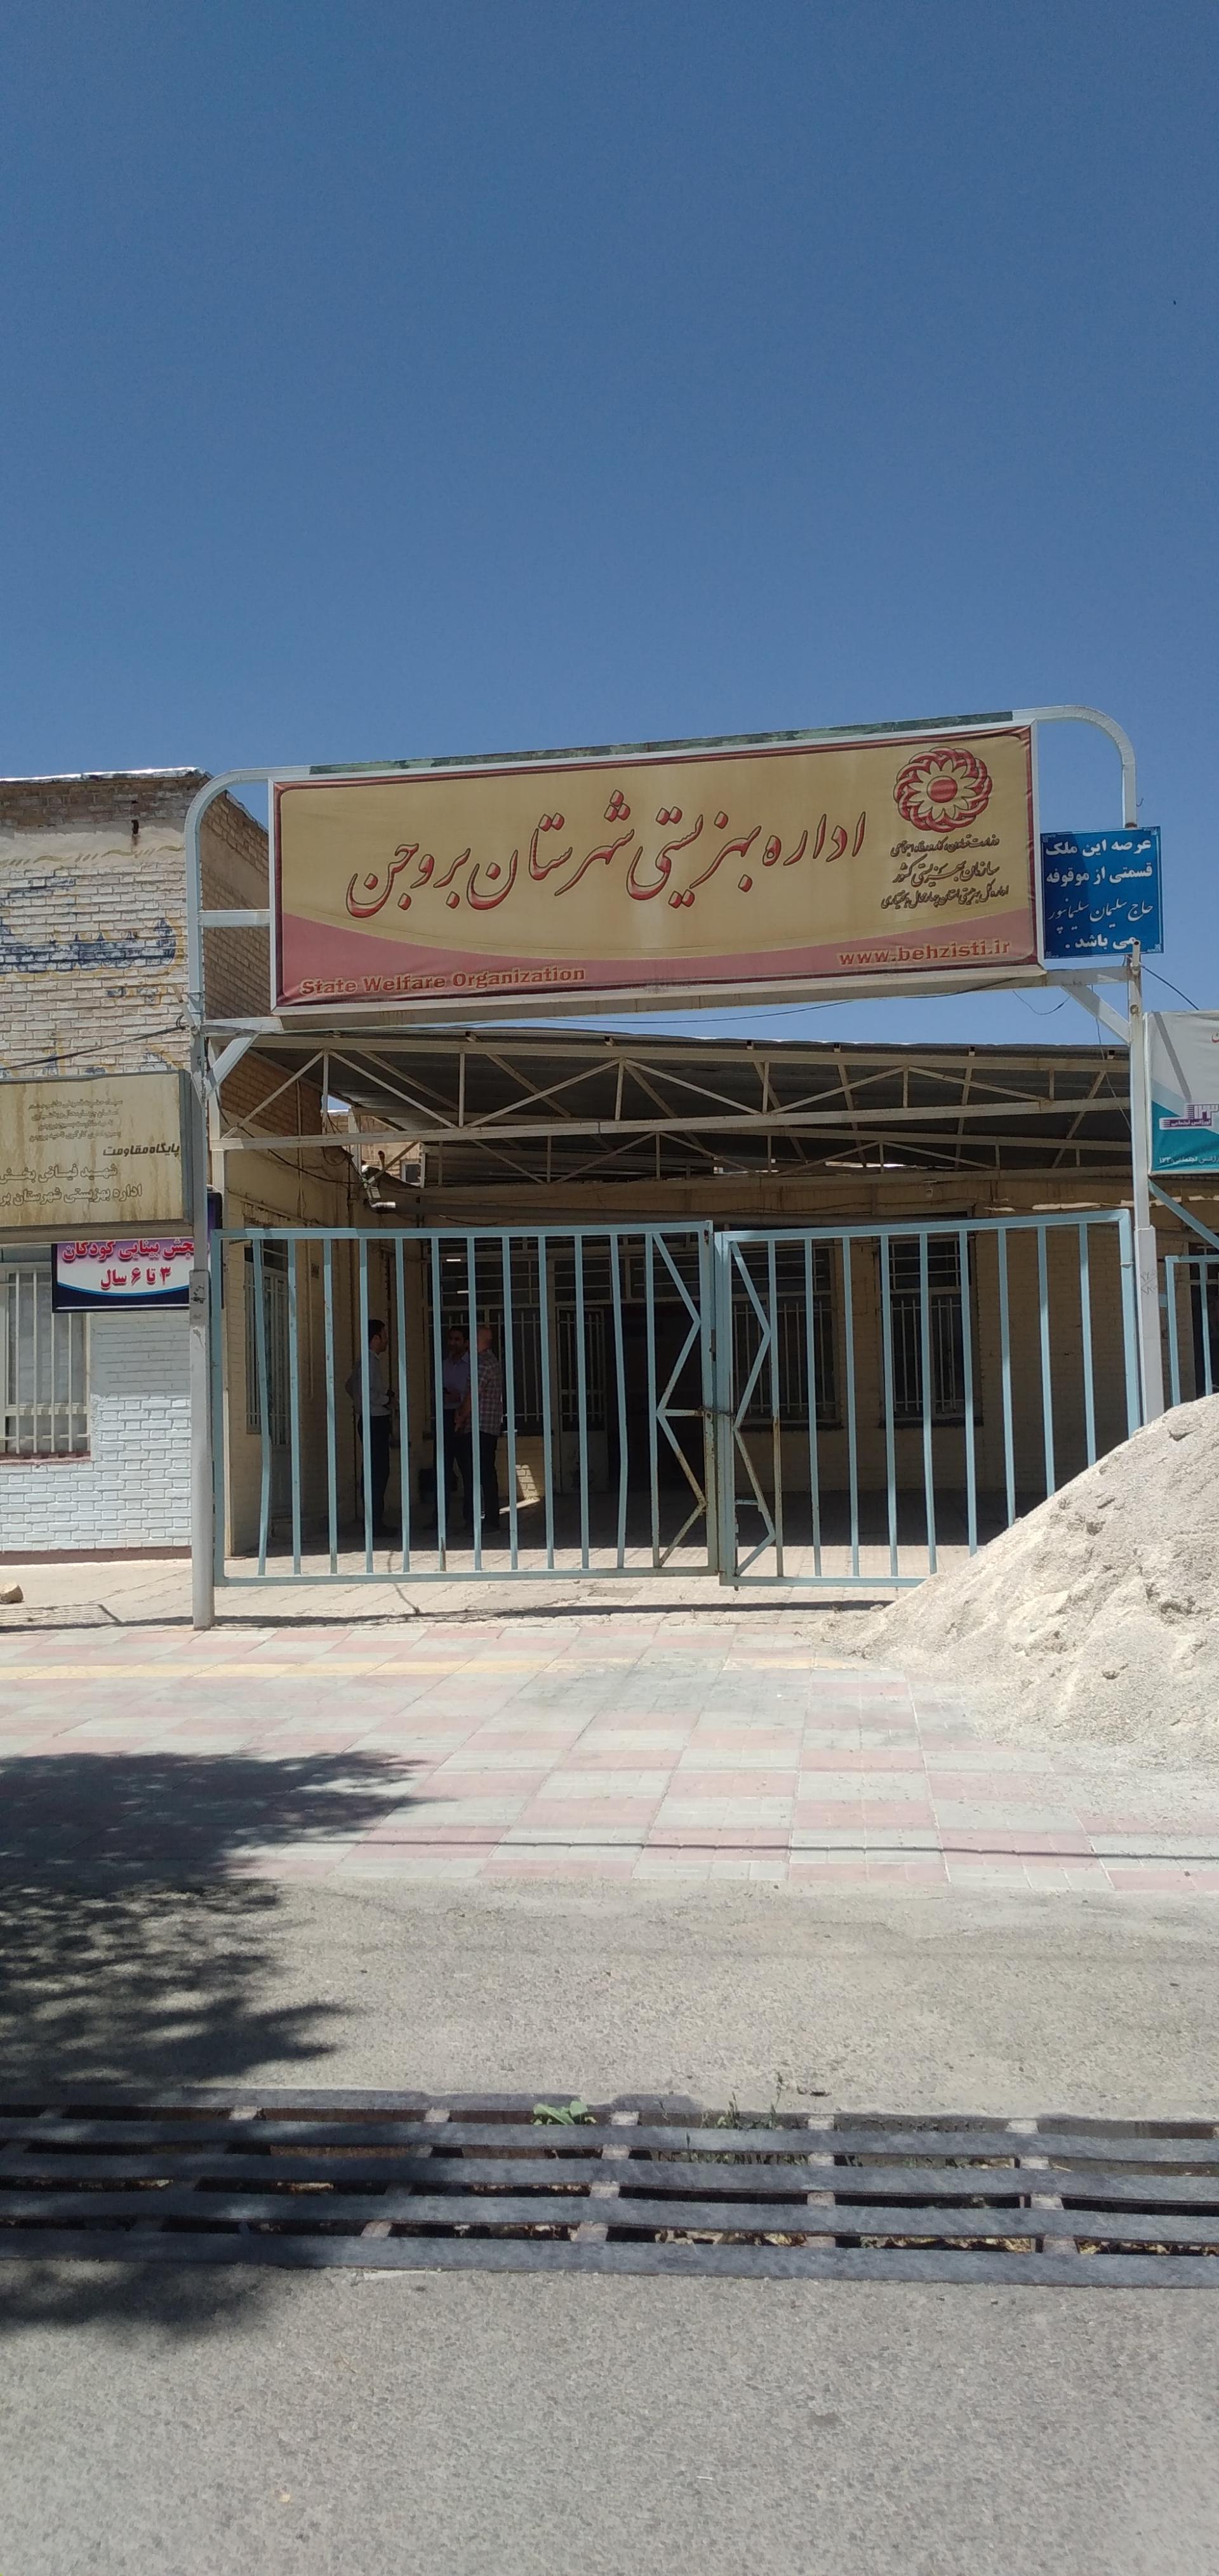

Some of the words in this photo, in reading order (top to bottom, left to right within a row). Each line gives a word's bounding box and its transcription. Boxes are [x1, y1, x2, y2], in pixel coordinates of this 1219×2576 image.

[762, 811, 866, 866] اداره
[1046, 840, 1078, 856] ملک
[1082, 839, 1107, 857] این
[1111, 839, 1152, 854] عرصه
[467, 789, 635, 910] شهرستان
[625, 806, 762, 909] بهزیستی
[892, 853, 928, 883] کشور
[911, 860, 967, 887] بهزیستی
[960, 861, 1000, 882] سازمان
[1046, 867, 1089, 887] موقوفه
[1093, 866, 1105, 885] از
[1109, 861, 1153, 884] قسمتی
[346, 842, 471, 918] بروجن
[1089, 898, 1128, 929] سلیمان
[1127, 900, 1154, 922] حاج
[838, 939, 1011, 966] www.behzisti.ir
[300, 977, 357, 997] State
[363, 974, 446, 992] Welfare
[452, 966, 585, 988] Organization
[103, 1145, 149, 1157] مقاومت
[149, 1143, 180, 1157] پایگاه
[38, 1163, 78, 1183] فیاض
[80, 1163, 118, 1180] شهید
[13, 1186, 62, 1206] شهرستان
[63, 1187, 110, 1204] بهزیستی
[112, 1183, 142, 1202] اداره
[63, 1239, 116, 1261] کودکان
[119, 1239, 159, 1260] بینایی
[100, 1269, 127, 1289] سال
[131, 1267, 142, 1285] ۶
[146, 1267, 156, 1284] تا
[160, 1266, 171, 1285] ۳
